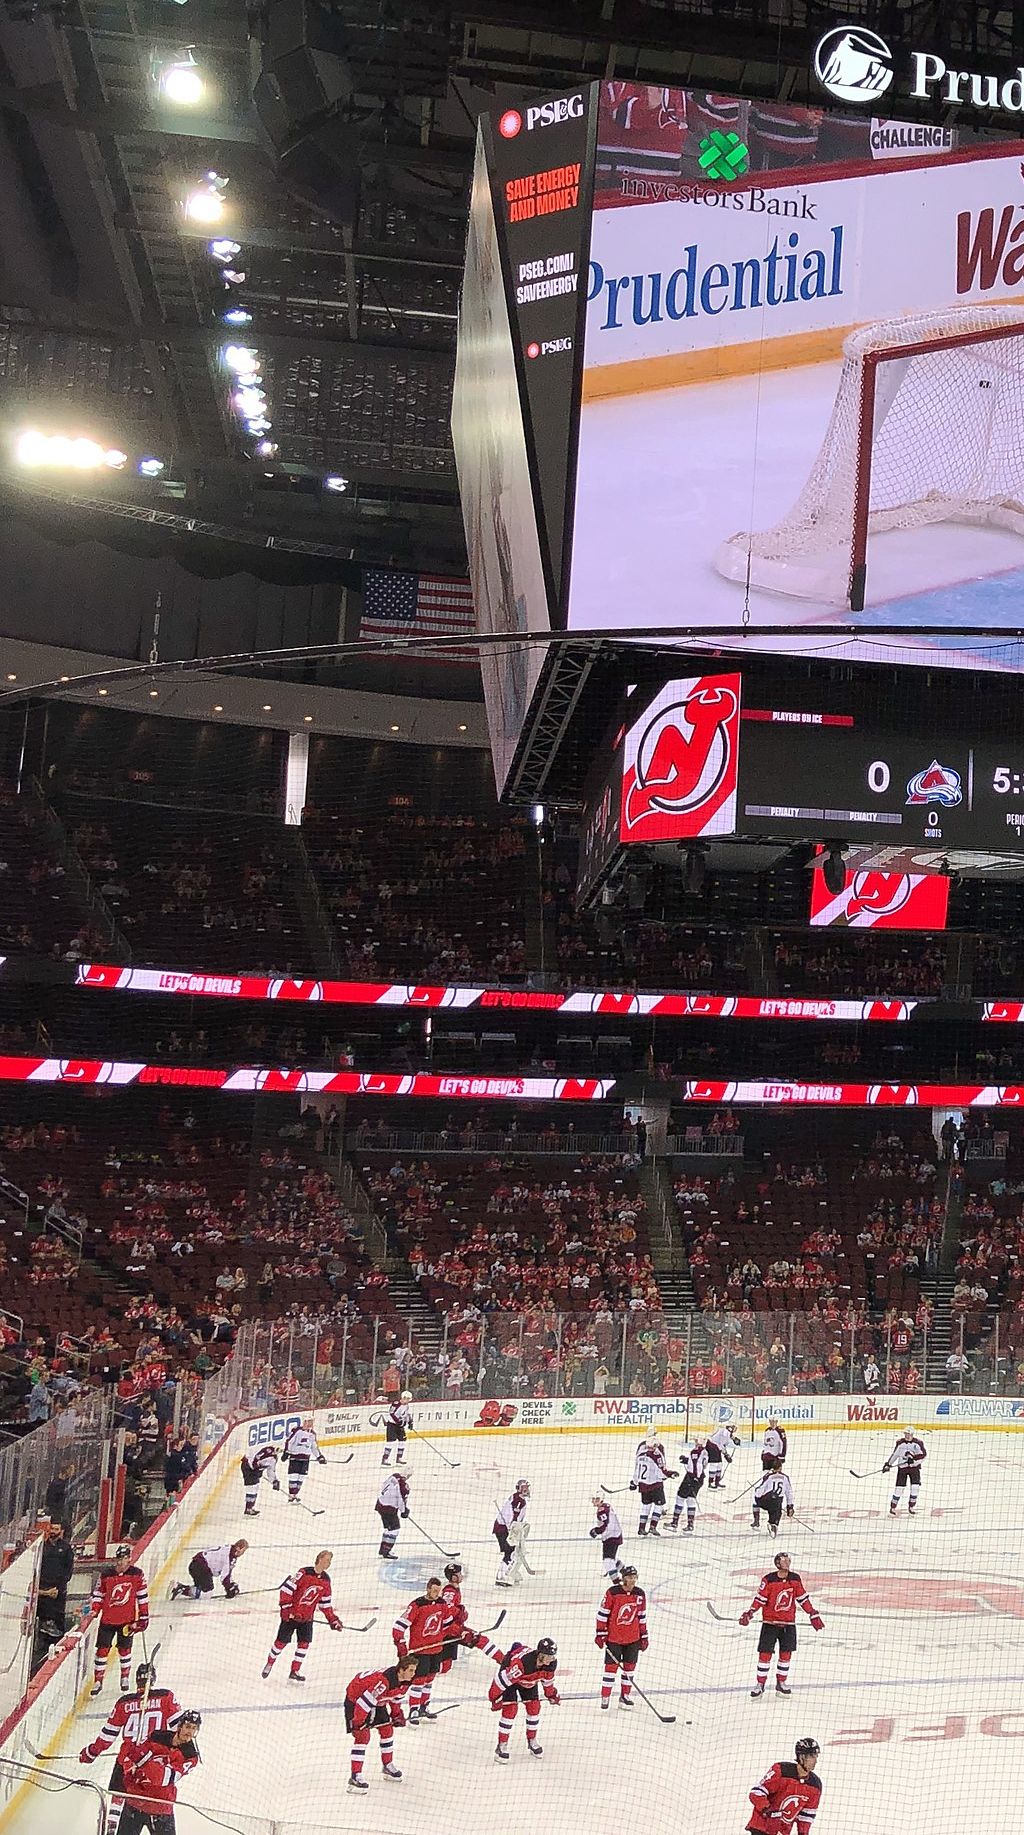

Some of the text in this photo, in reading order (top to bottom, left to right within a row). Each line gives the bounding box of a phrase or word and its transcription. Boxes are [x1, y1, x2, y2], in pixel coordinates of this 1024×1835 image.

[871, 128, 950, 150] CHALLENGE
[506, 163, 580, 202] SAVE ENERGY
[510, 186, 579, 222] AND MONEY
[520, 252, 574, 282] PSEG.COM/
[587, 226, 844, 330] Prudential
[516, 274, 578, 304] SAVEENERGY
[773, 711, 800, 723] PLAYERS
[812, 714, 823, 724] ICE
[867, 761, 890, 792] 0
[770, 807, 800, 818] PENALTY
[849, 812, 878, 822] PENALTY
[928, 812, 938, 827] 0
[924, 828, 942, 838] SHOTS
[1016, 827, 1022, 836] 1
[159, 975, 241, 994] LET'S GO DEVILS
[760, 1000, 835, 1016] LET'S GO DEVILS
[438, 1079, 523, 1095] LET'S GO DEVILS
[763, 1085, 842, 1101] LET'S GO DEVILS
[897, 1334, 909, 1345] 19
[594, 1400, 703, 1414] RWJBarnabas
[739, 1404, 814, 1420] Prudential
[847, 1404, 899, 1421] Wawa
[951, 1399, 1013, 1417] HALMAR
[608, 1415, 653, 1424] HEALTH
[248, 1417, 301, 1446] GEICO
[347, 1423, 361, 1433] LIVE
